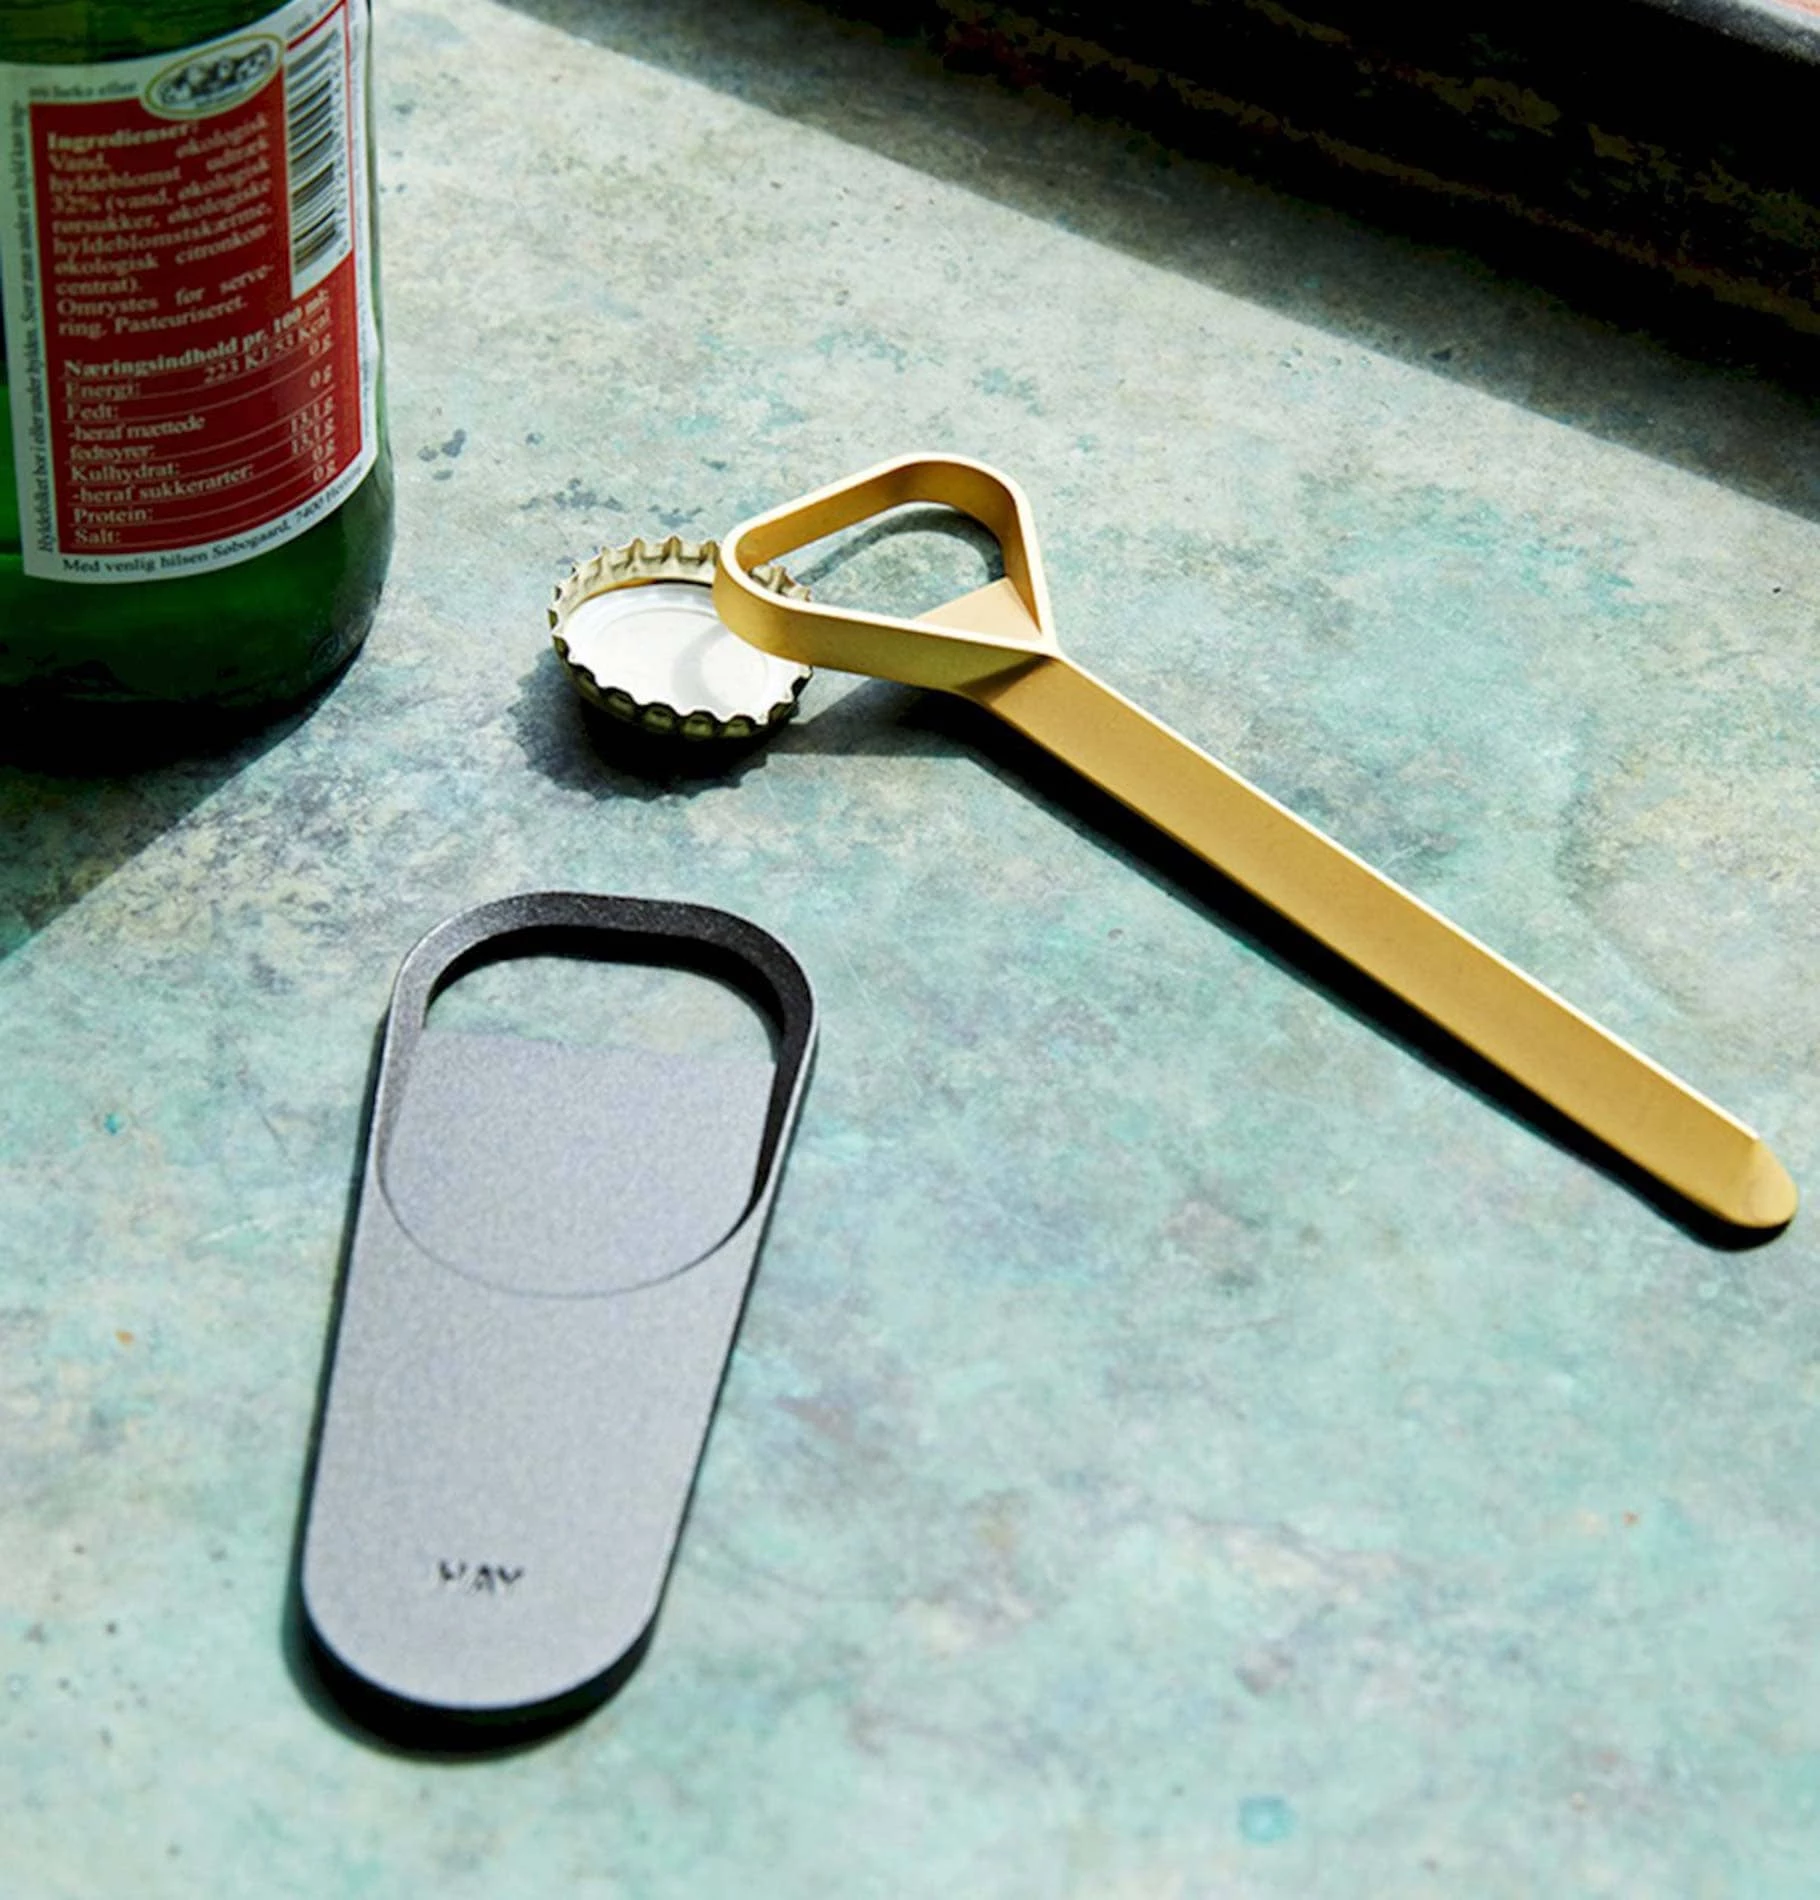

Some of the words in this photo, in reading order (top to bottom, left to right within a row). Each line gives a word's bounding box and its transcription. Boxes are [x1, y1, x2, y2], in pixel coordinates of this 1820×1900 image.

[48, 121, 199, 153] Ingredienser:
[56, 297, 160, 319] Omrystes
[219, 263, 274, 295] serve-
[114, 295, 248, 335] Pasteuriseret.
[64, 336, 238, 379] Næringsindhold
[243, 329, 269, 354] pr.
[65, 379, 141, 401] Energi:
[66, 401, 120, 421] Fedt:
[68, 421, 126, 442] -heraf
[70, 463, 181, 484] Kulhydrat:
[72, 484, 135, 504] -heraf
[138, 463, 254, 501] sukkerarter:
[73, 504, 154, 525] Protein:
[74, 527, 122, 545] Salt:
[62, 558, 101, 574] Med
[105, 555, 156, 573] venlig
[160, 550, 209, 570] hilsen
